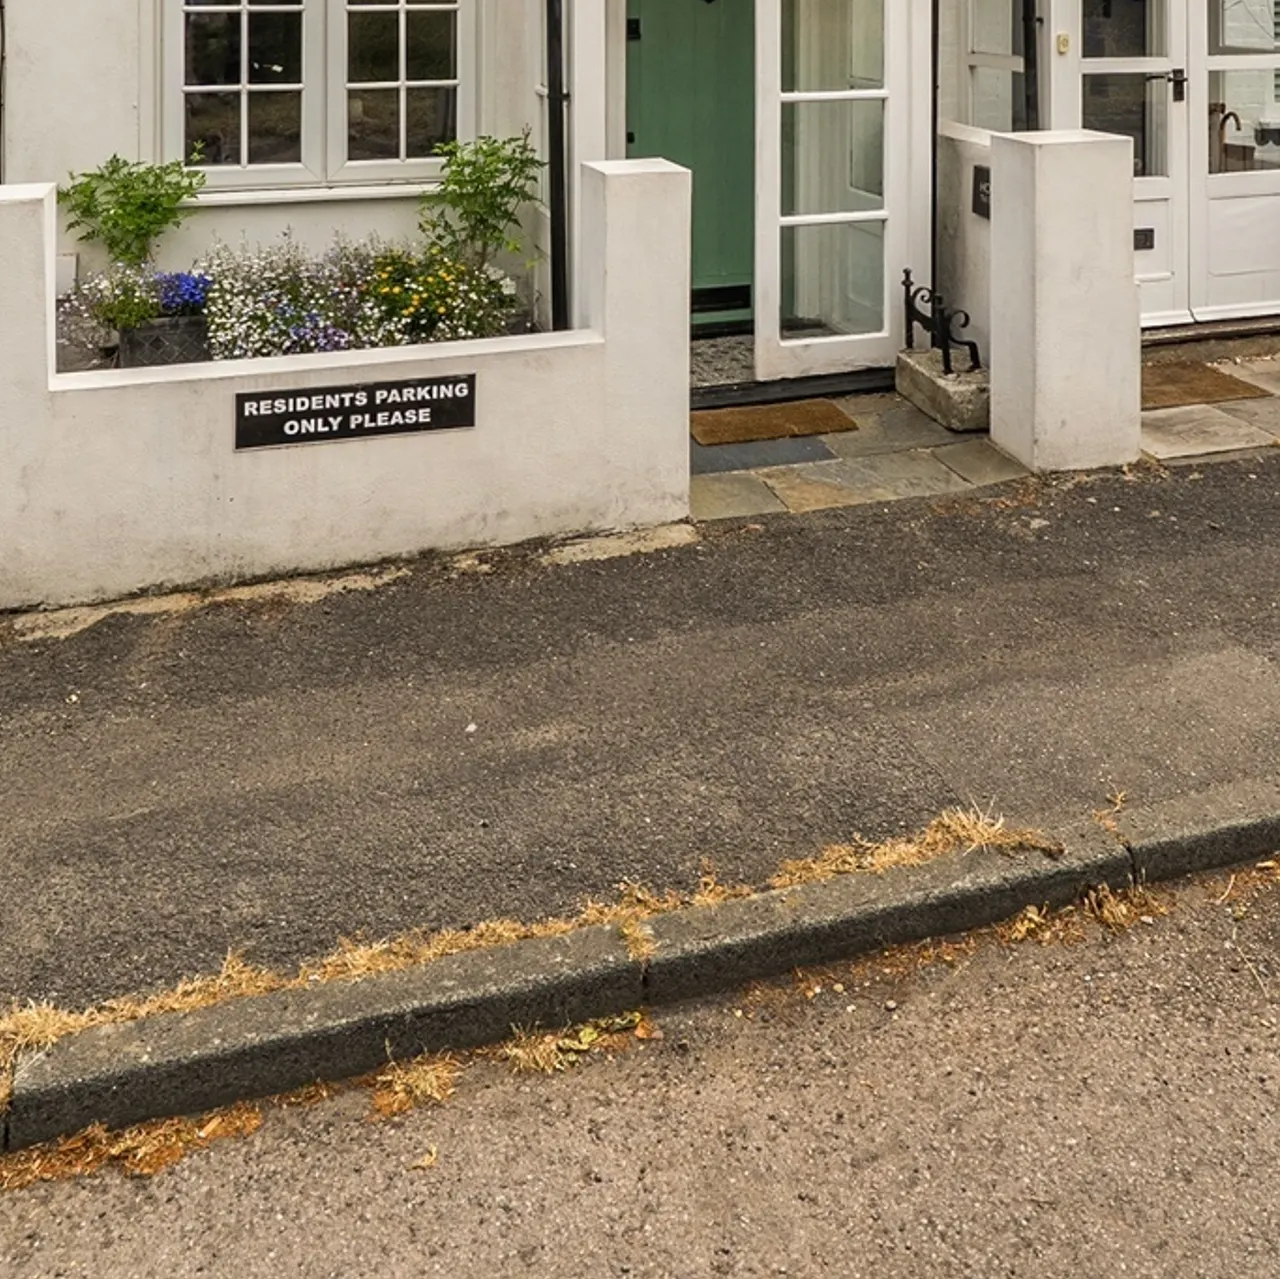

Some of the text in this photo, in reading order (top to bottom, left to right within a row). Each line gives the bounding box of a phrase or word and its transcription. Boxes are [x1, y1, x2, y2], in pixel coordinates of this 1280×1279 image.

[244, 382, 469, 417] RESIDENTS PARKING
[283, 408, 432, 435] ONLY PLEASE
